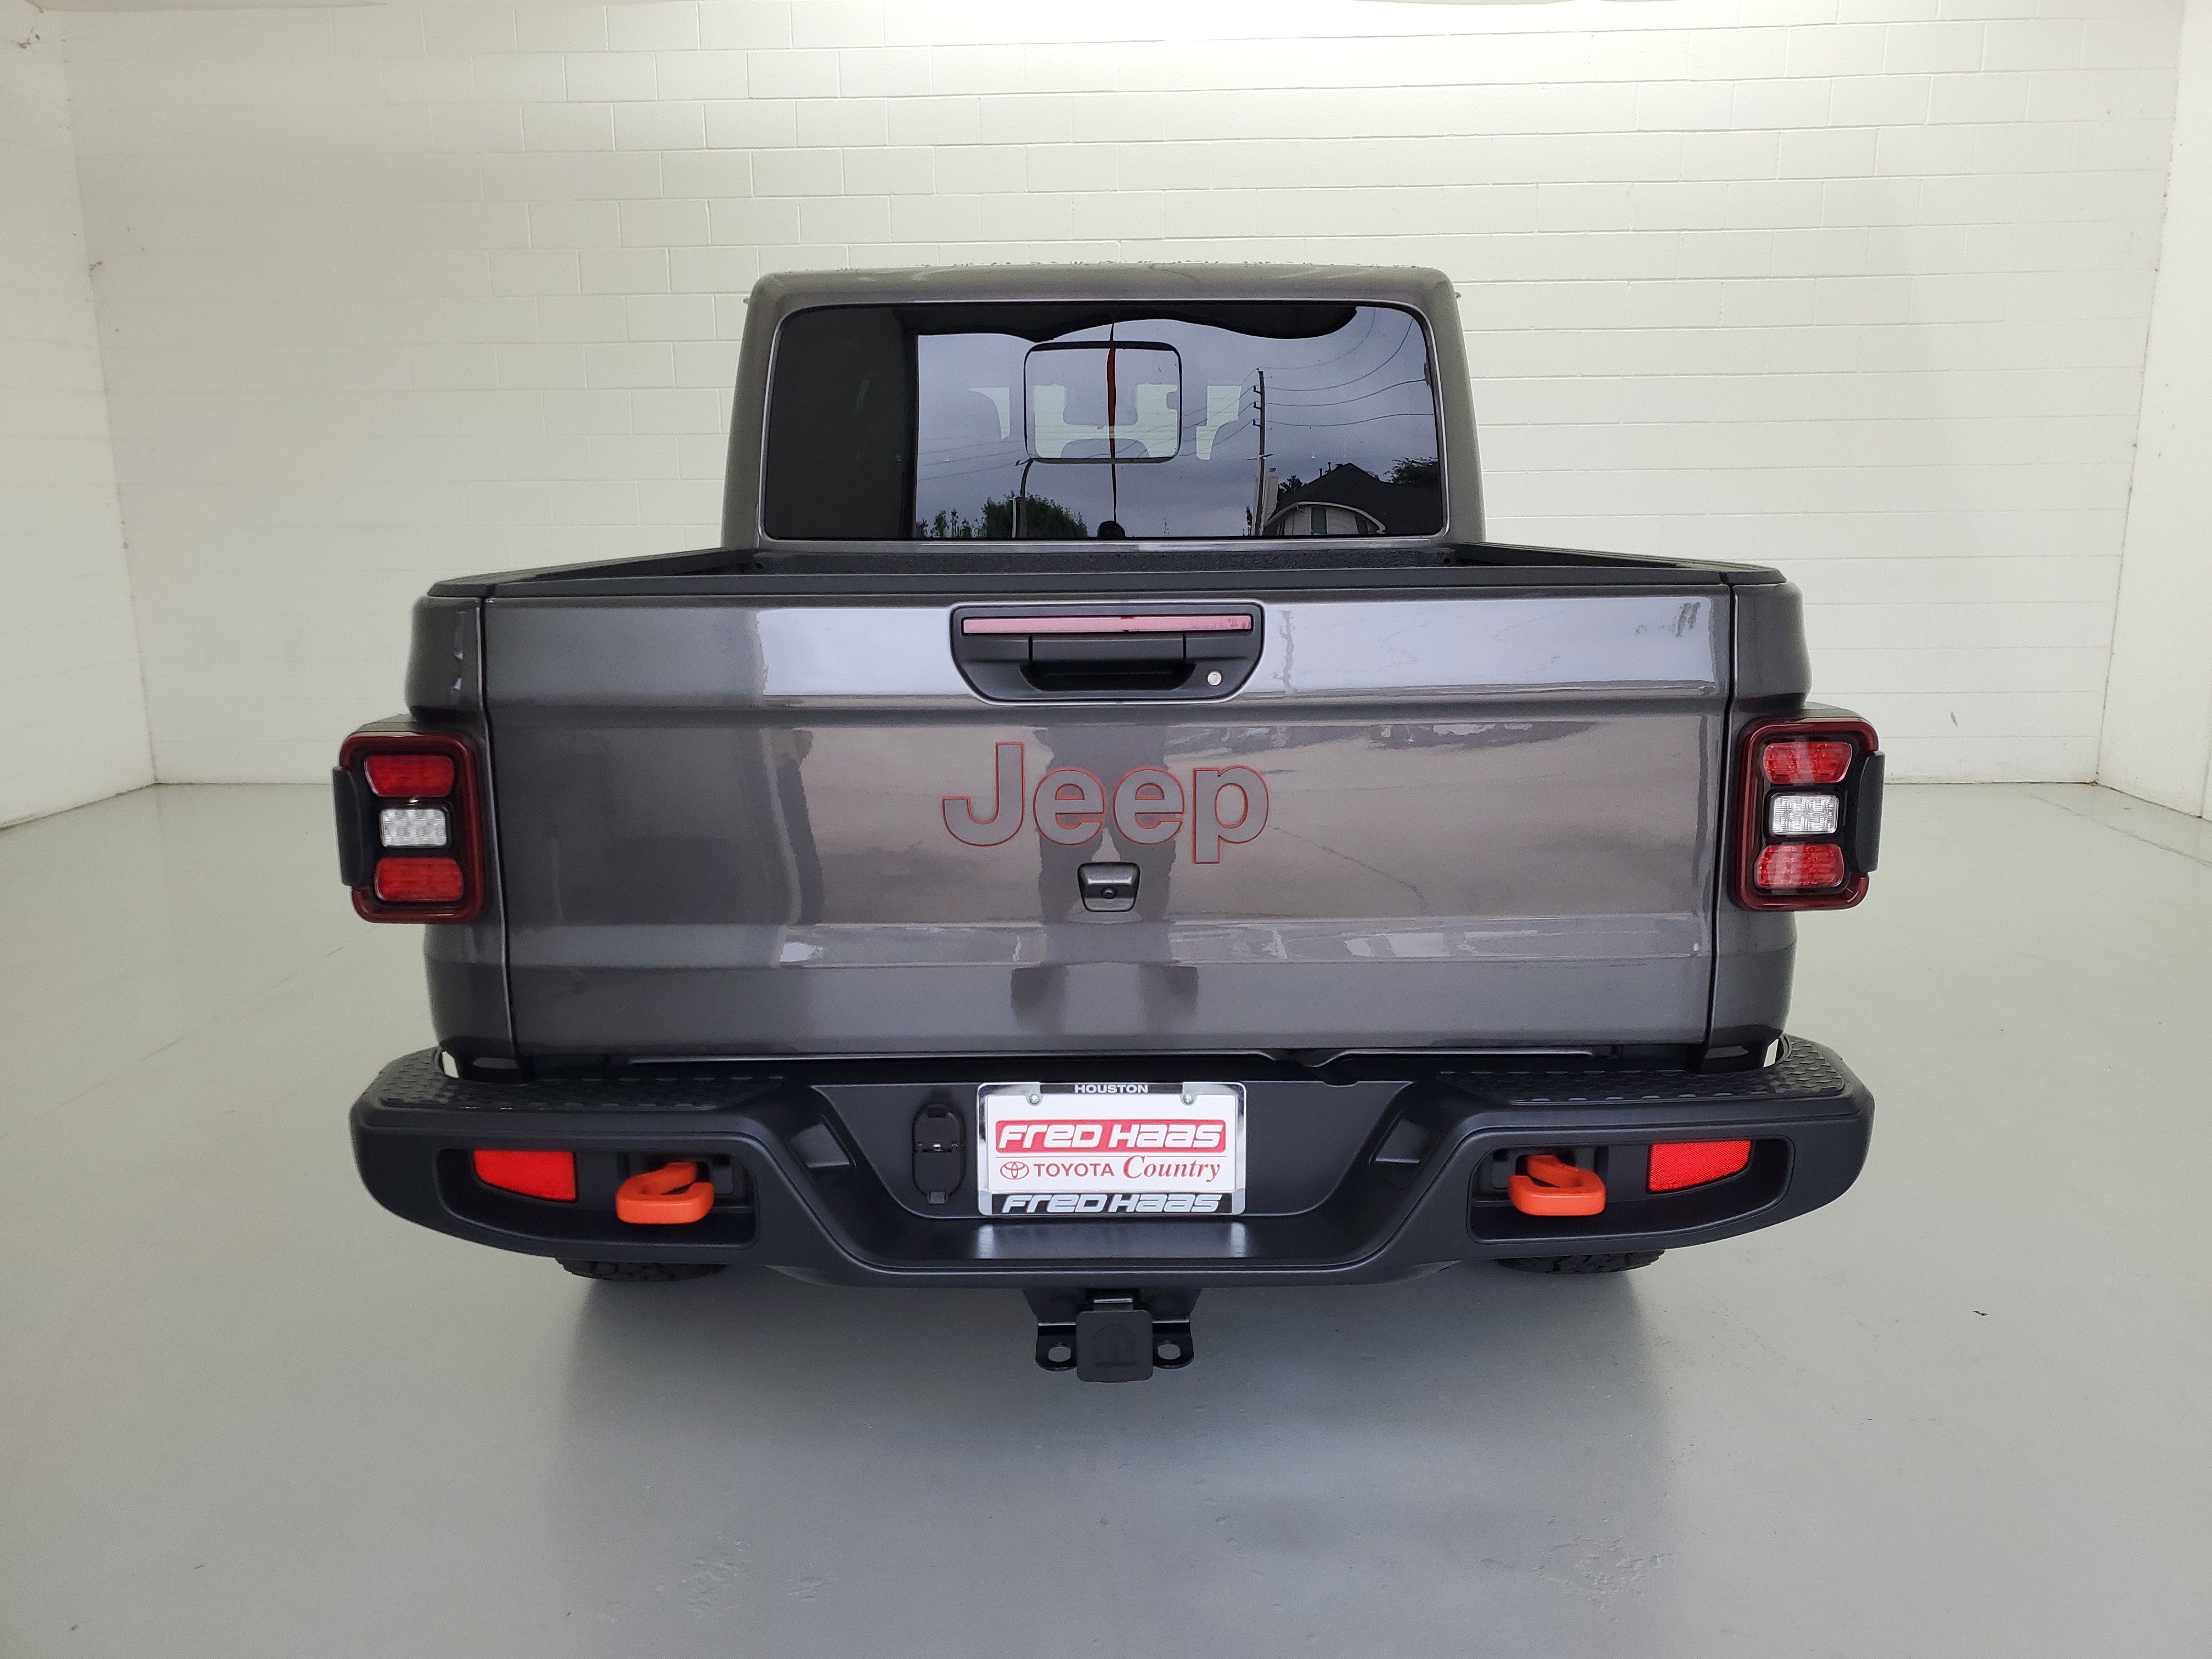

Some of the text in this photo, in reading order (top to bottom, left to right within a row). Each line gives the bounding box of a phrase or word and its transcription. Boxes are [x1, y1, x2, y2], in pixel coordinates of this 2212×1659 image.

[942, 742, 1269, 864] Jeep
[1074, 1084, 1148, 1093] HOUSTON
[1033, 1155, 1221, 1182] TOYOTA Country
